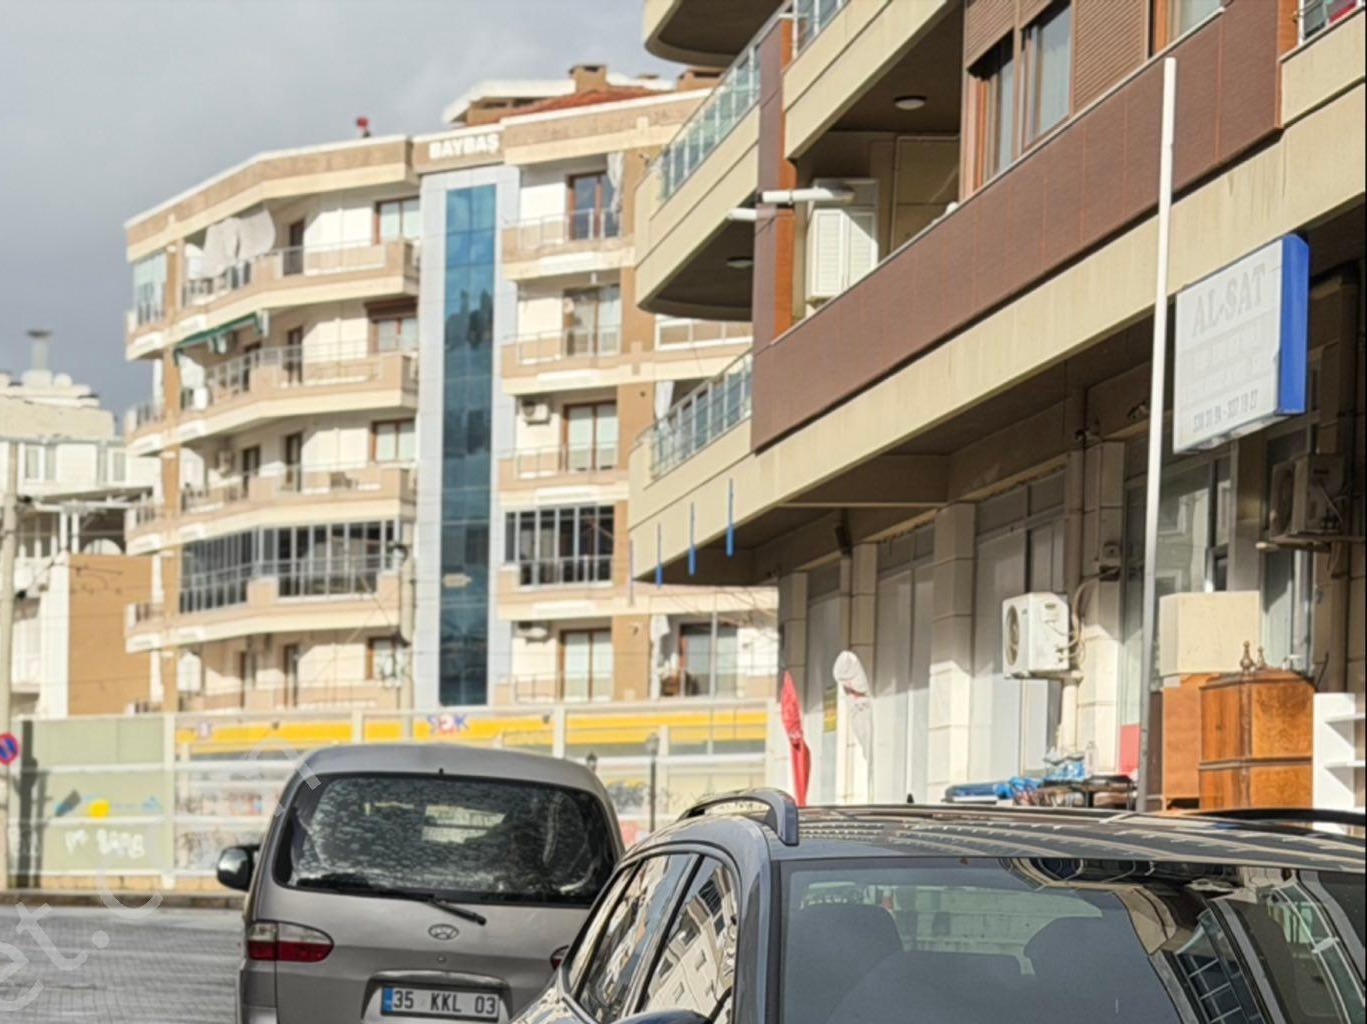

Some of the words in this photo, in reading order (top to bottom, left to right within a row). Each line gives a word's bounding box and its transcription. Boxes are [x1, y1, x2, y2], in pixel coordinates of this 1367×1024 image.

[1192, 262, 1266, 337] AL-SAT
[394, 990, 414, 1010] 35
[430, 992, 462, 1013] KKL
[474, 995, 496, 1015] 03
